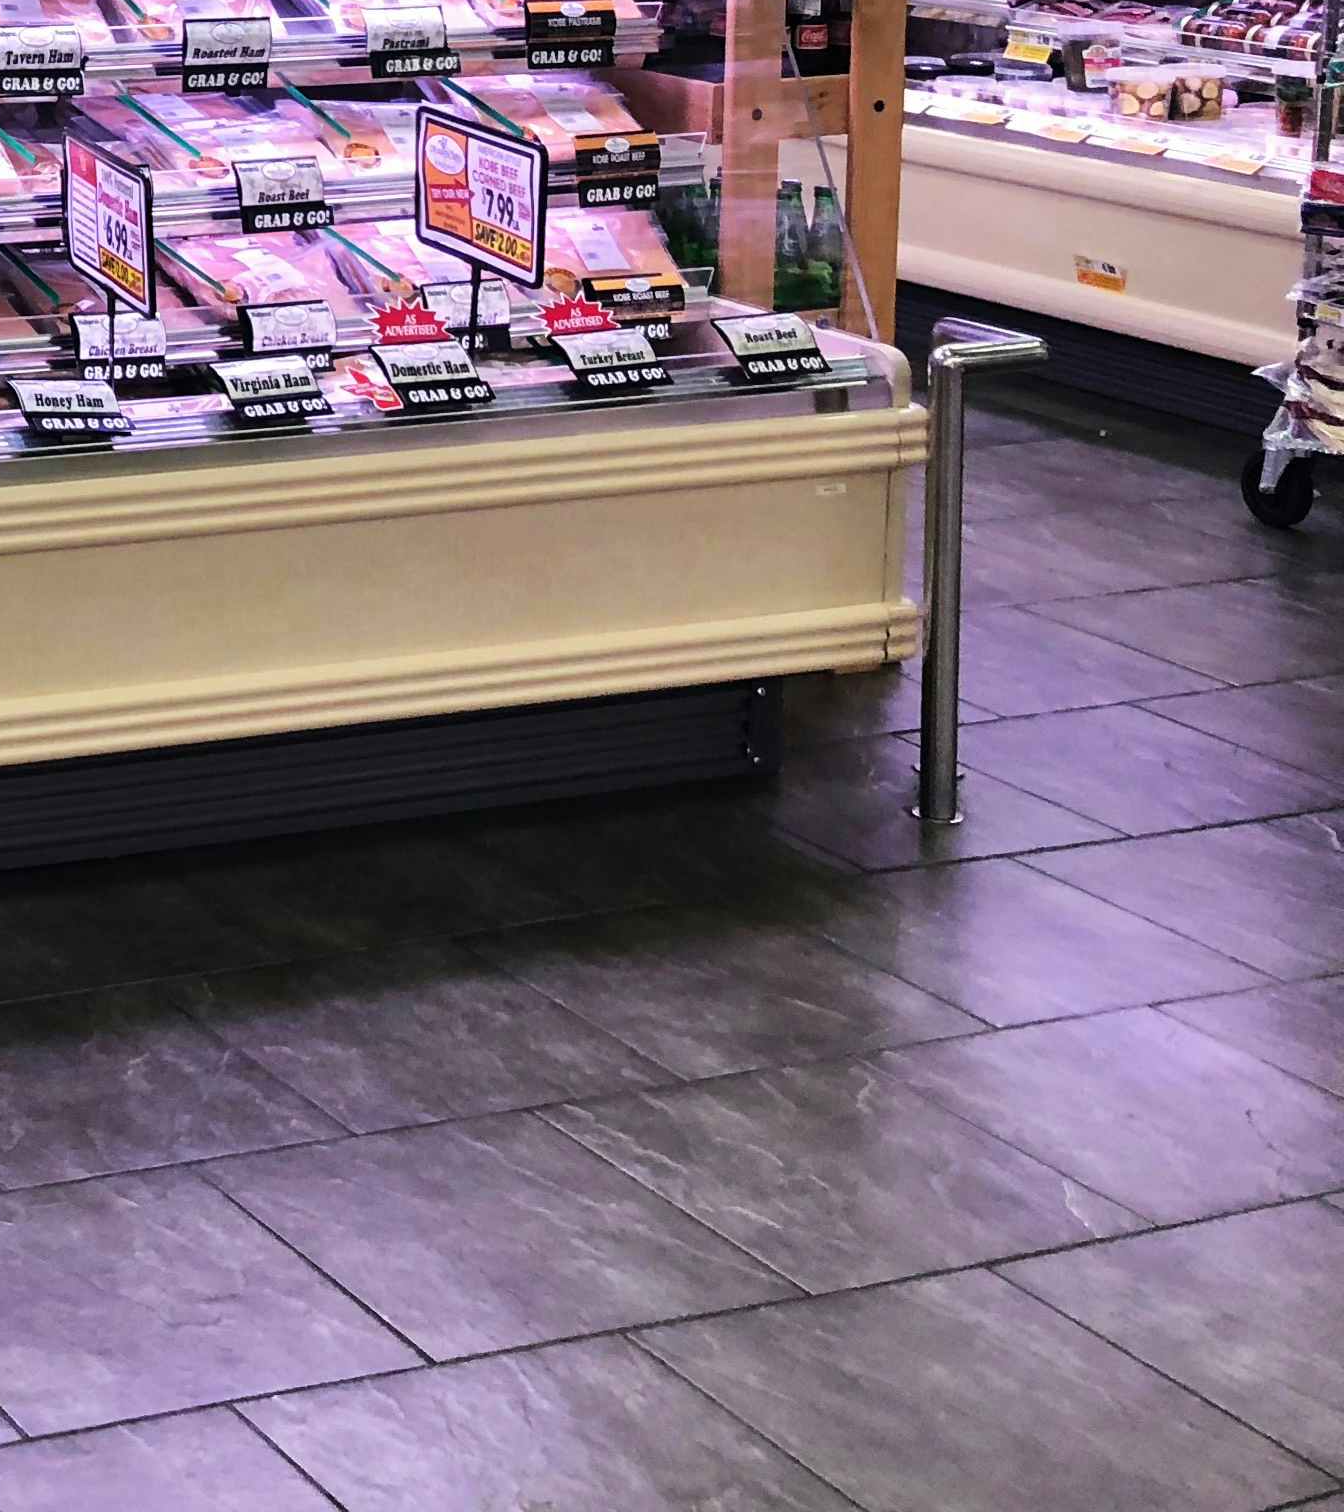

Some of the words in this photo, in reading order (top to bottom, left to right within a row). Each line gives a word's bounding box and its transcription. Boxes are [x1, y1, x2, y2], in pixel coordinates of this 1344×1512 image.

[6, 51, 44, 65] Tavern
[47, 50, 73, 63] Ham
[193, 46, 236, 59] Roasted
[239, 46, 265, 58] Ham
[2, 77, 40, 90] GRAB
[43, 76, 54, 90] &
[57, 76, 80, 90] GO!
[258, 190, 286, 204] Roast
[288, 189, 310, 202] Beef
[404, 314, 418, 325] AS
[385, 323, 438, 337] ADVERTISED
[745, 331, 772, 344] Roast
[774, 328, 799, 341] Beef
[580, 354, 613, 368] Turkey
[616, 350, 646, 364] Breast
[748, 359, 786, 374] GRAB
[789, 357, 800, 372] &
[801, 355, 825, 371] GO!
[391, 361, 442, 378] Domestic
[445, 361, 470, 374] Ham
[230, 377, 279, 394] Virginia
[282, 374, 310, 388] Ham
[34, 393, 72, 410] Honey
[76, 395, 104, 408] Ham
